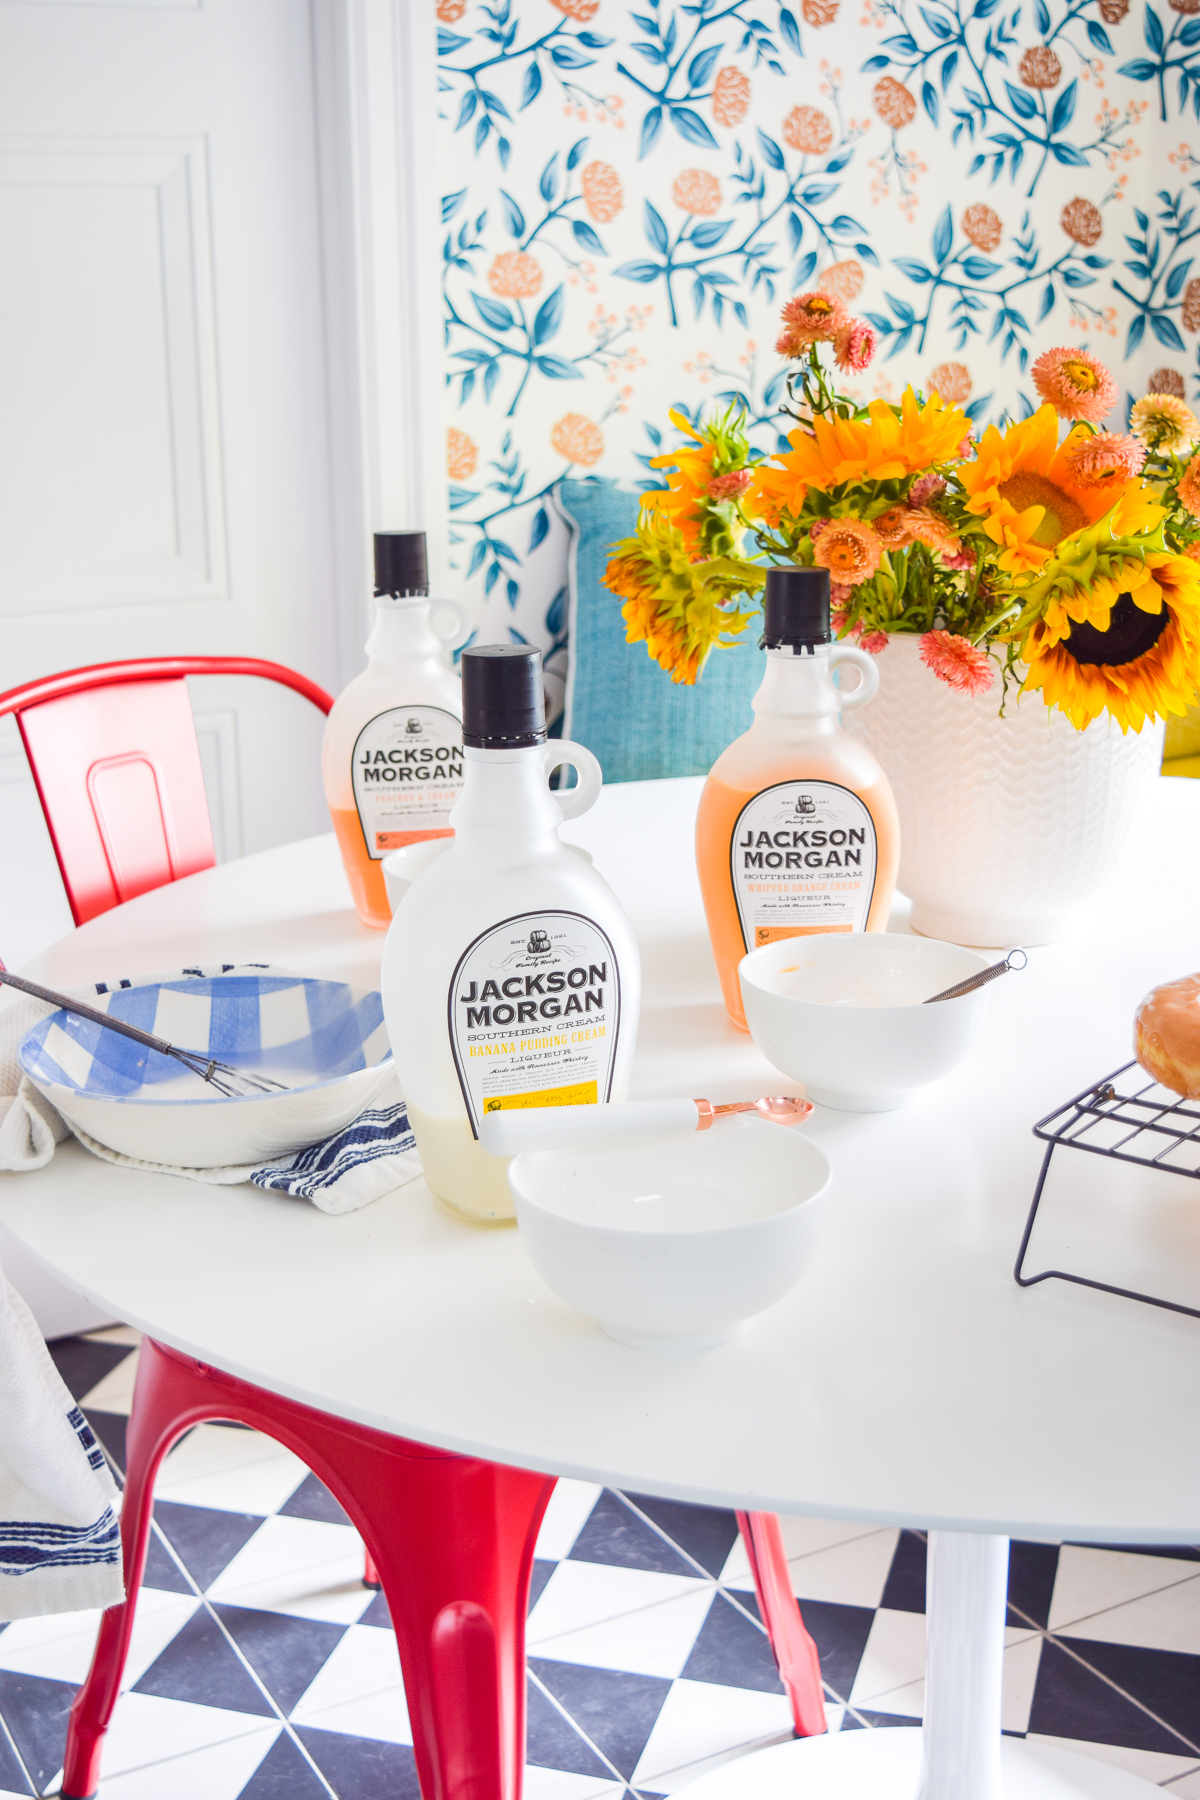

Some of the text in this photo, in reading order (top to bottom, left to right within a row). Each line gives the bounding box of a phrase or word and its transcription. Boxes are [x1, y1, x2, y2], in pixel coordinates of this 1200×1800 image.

[360, 746, 464, 764] JACKSON
[364, 764, 462, 782] MORGAN
[740, 827, 865, 848] JACKSON
[744, 849, 861, 869] MORGAN
[818, 871, 863, 879] CREAM
[747, 881, 860, 893] WHIPPED ORANGE CREAM
[525, 953, 552, 962] Original
[460, 962, 607, 1003] JACKSON
[466, 988, 604, 1028] MORGAN
[467, 1015, 606, 1041] SOUTHERN CREAM
[469, 1026, 606, 1057] BANANA PUDDING CREAM
[510, 1049, 572, 1063] LIQUEUR
[527, 1061, 561, 1069] Tennessee
[562, 1055, 589, 1063] Whiskey
